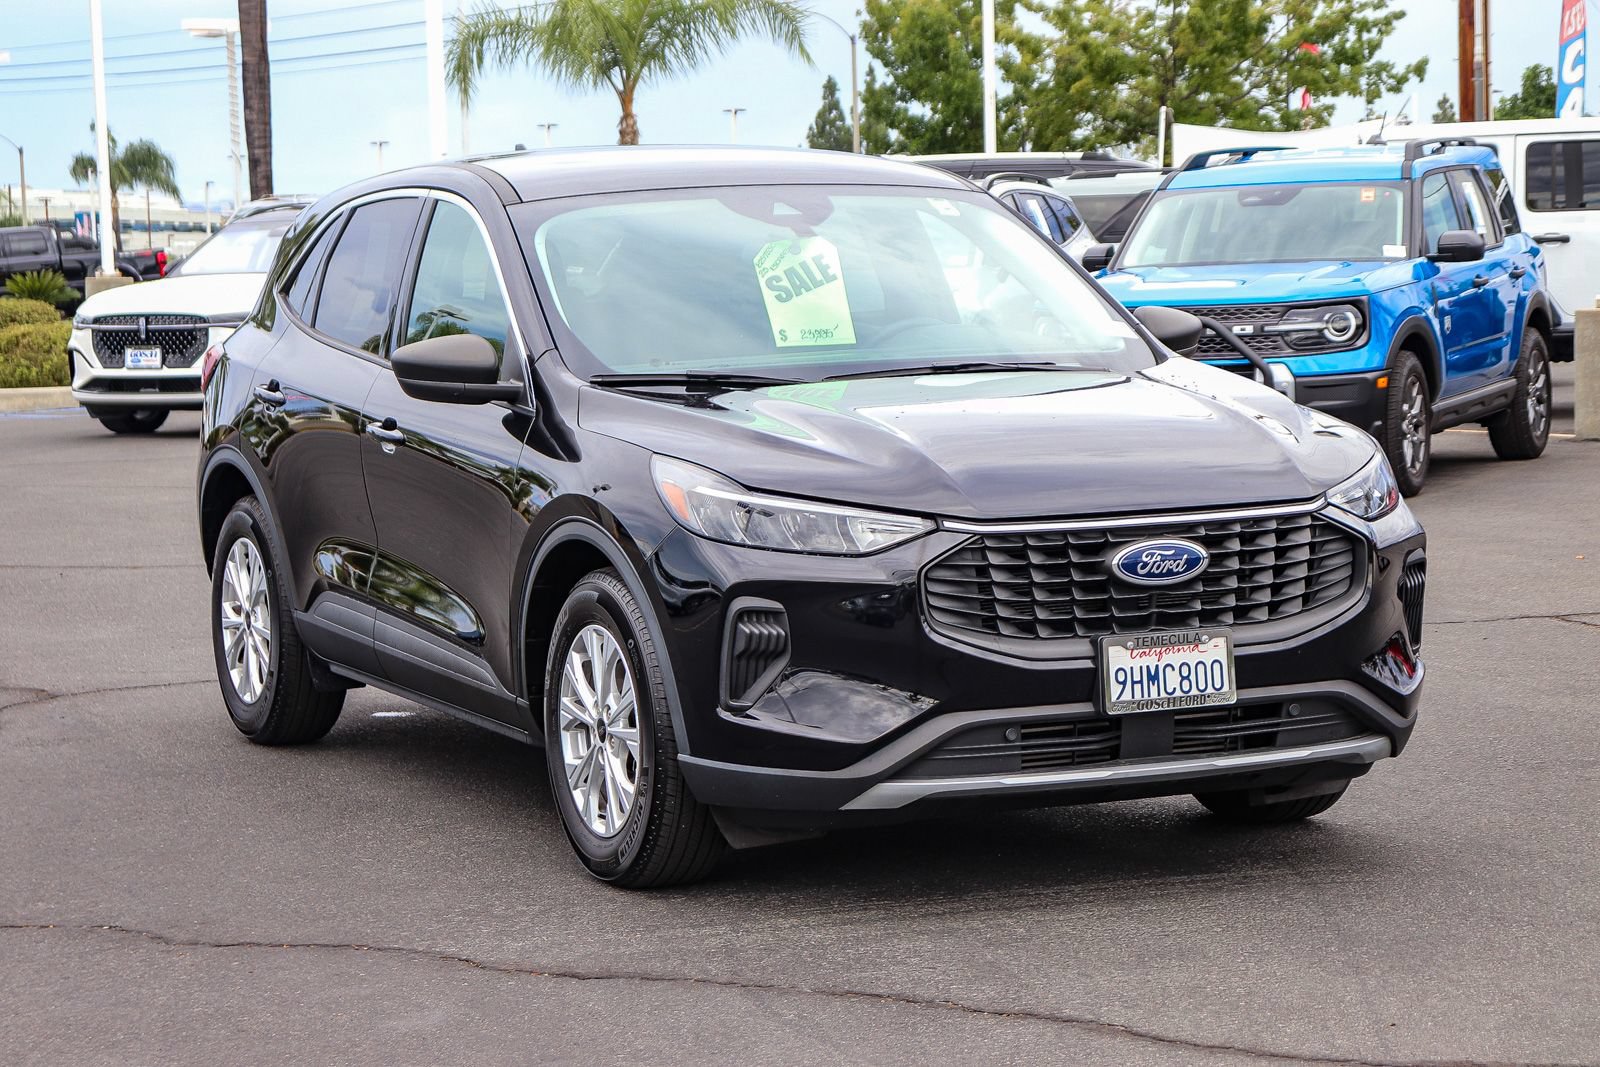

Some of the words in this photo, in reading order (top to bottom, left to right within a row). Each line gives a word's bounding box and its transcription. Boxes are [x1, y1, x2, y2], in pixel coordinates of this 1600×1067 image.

[765, 254, 838, 303] SALE
[1137, 549, 1188, 575] Ford
[1134, 633, 1201, 648] TEMECULA
[1114, 658, 1225, 701] 9HMC800
[1179, 694, 1207, 708] FORD
